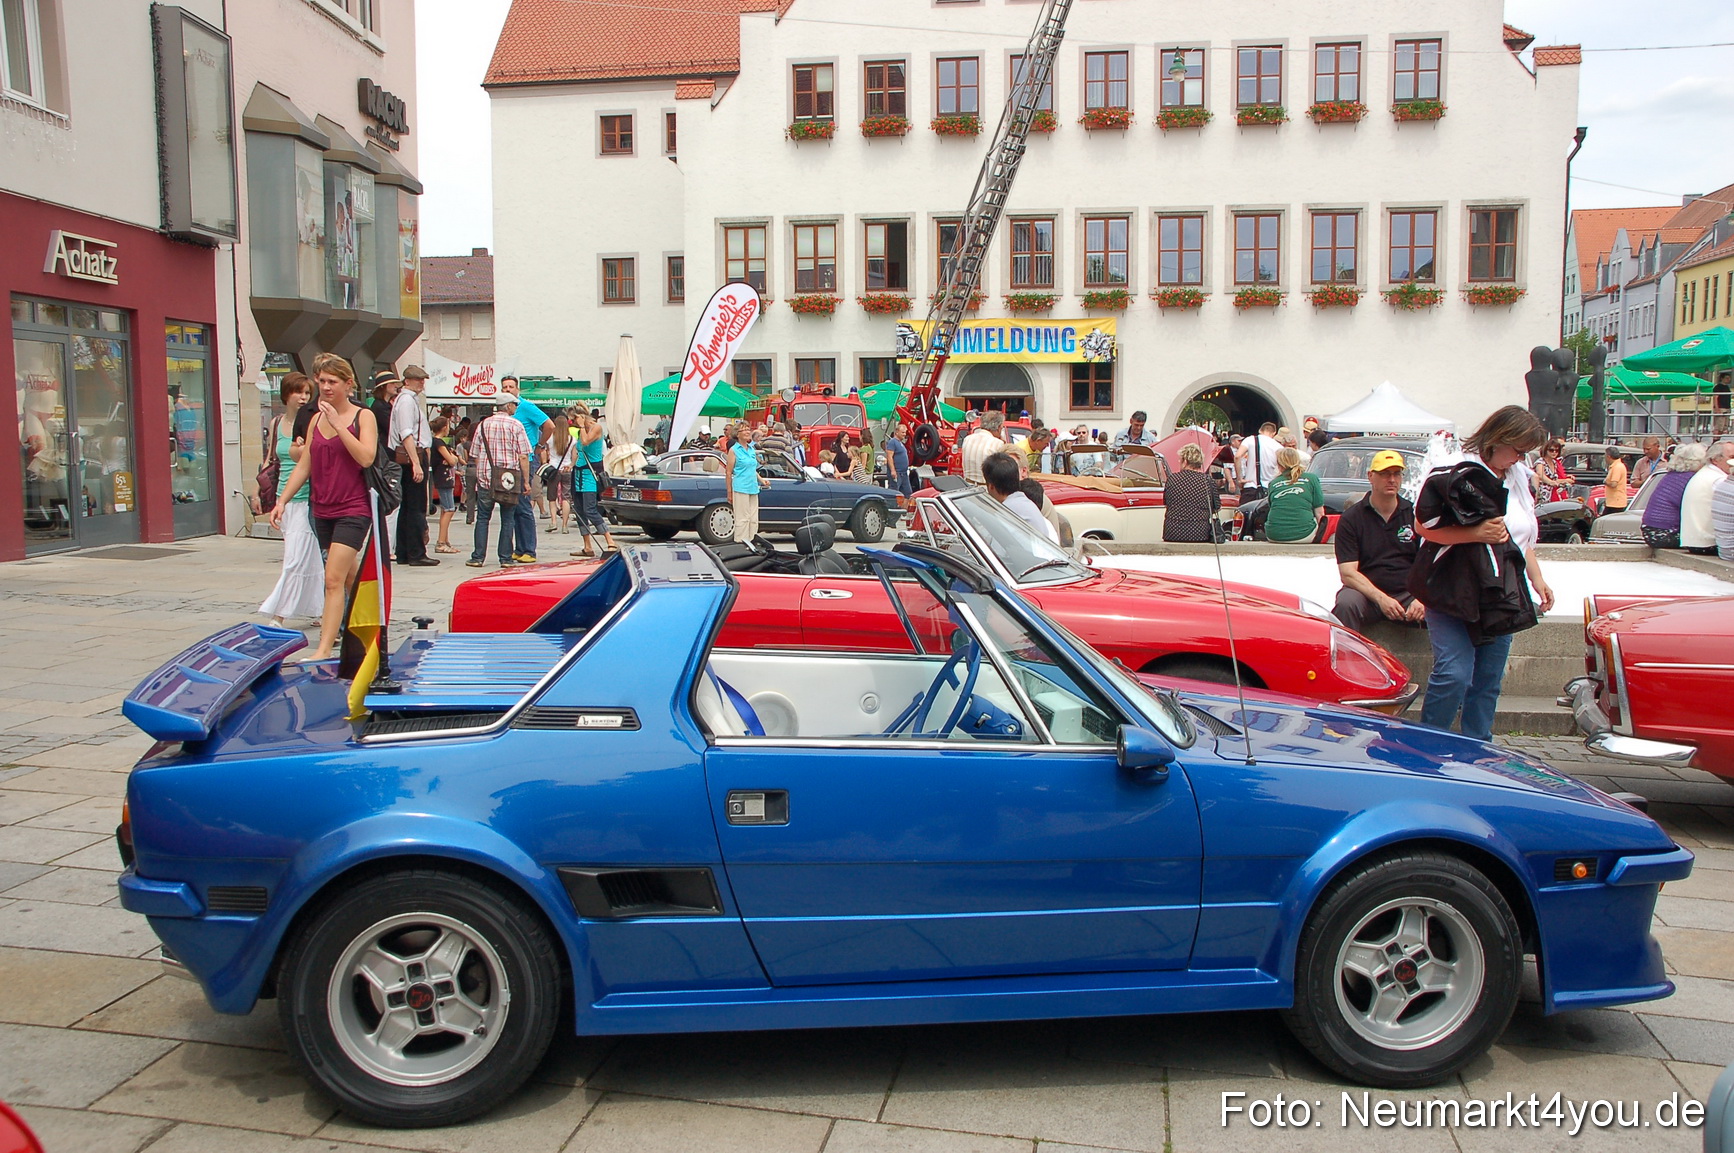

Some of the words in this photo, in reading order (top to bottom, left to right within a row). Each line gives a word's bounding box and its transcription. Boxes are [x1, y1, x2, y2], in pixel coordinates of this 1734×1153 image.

[359, 78, 410, 136] RACKL
[44, 229, 119, 286] Achatz
[684, 294, 739, 390] Lehmeier's
[727, 302, 755, 339] IMBISS
[453, 364, 494, 396] Lehmeier's
